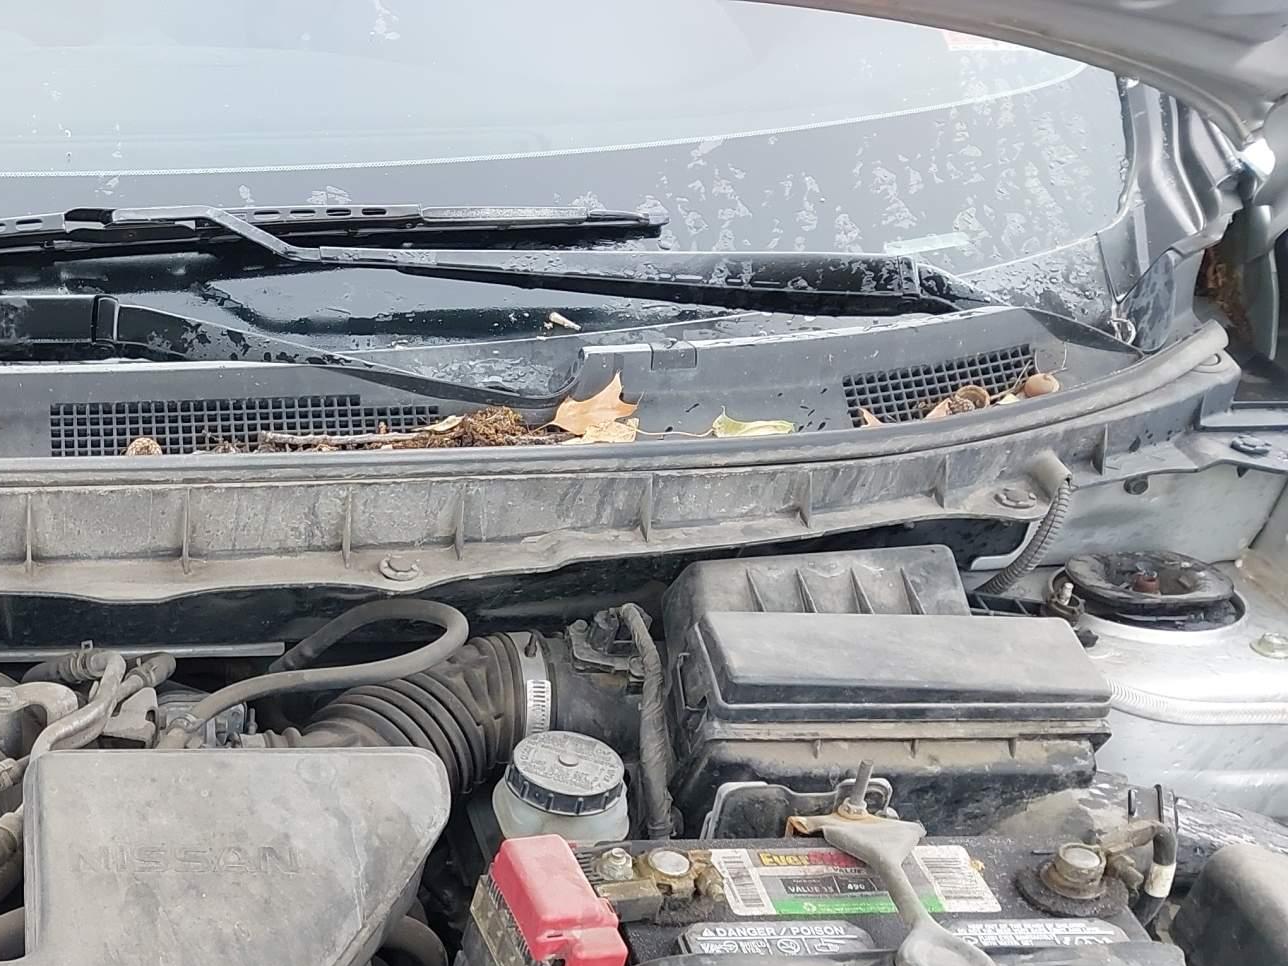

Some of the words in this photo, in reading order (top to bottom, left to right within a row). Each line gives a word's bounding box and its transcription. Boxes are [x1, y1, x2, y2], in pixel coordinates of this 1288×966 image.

[72, 845, 302, 874] NISSAN
[787, 885, 820, 893] VALUE
[847, 883, 865, 891] 490
[715, 927, 777, 937] DANGER
[789, 926, 846, 936] POISON
